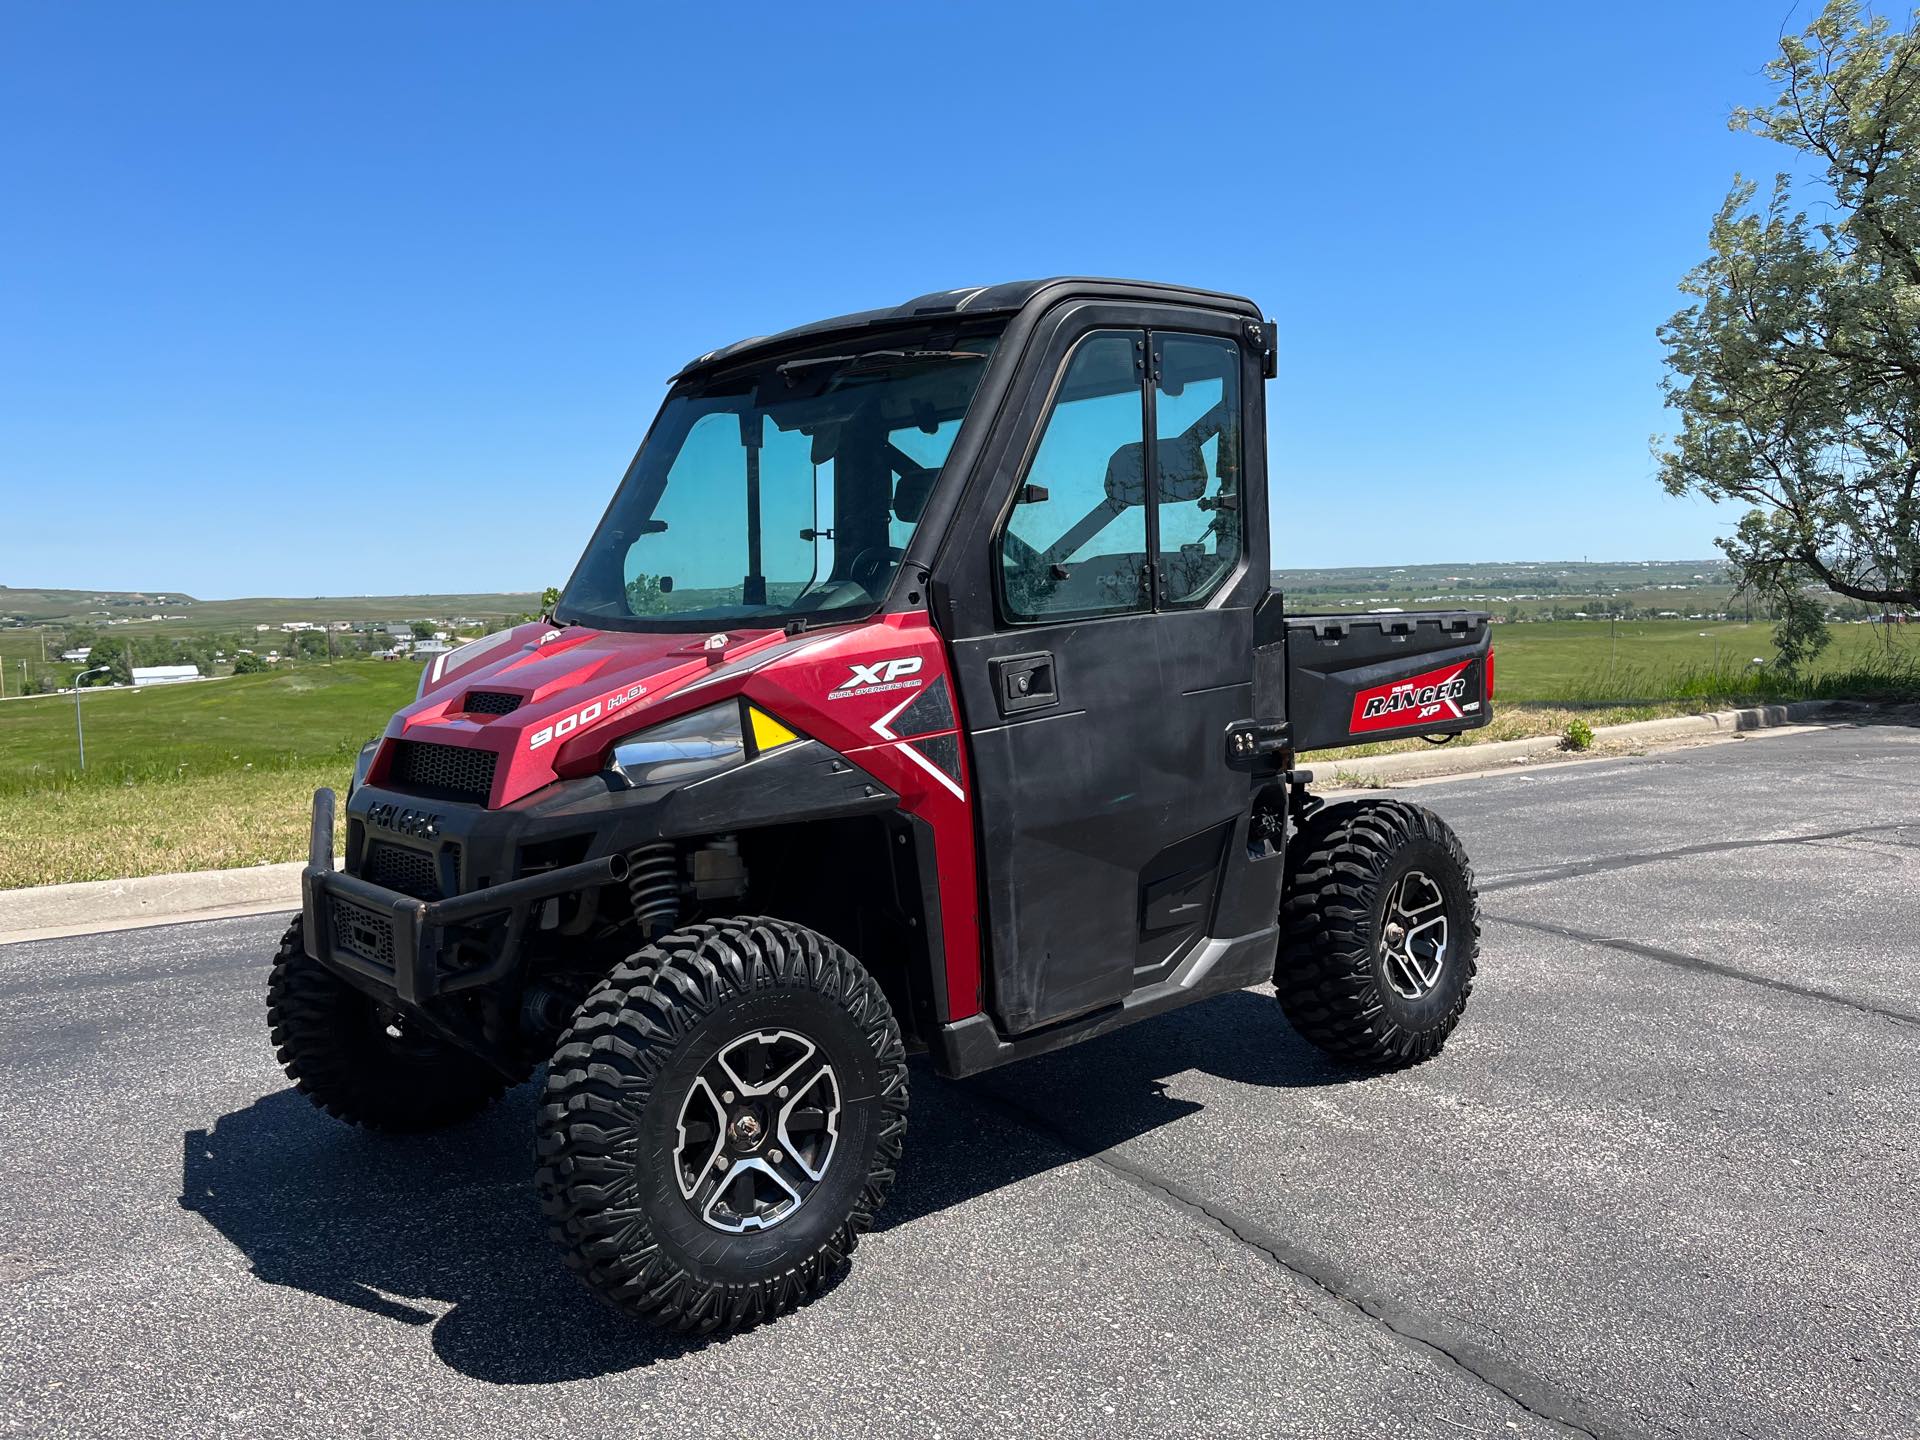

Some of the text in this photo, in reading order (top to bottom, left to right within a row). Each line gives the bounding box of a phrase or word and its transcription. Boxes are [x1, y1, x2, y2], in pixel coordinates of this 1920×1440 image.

[828, 679, 923, 701] DUAL OVERHEAD CAM
[838, 656, 923, 689] XP
[1362, 678, 1465, 719] RANGER
[1417, 704, 1441, 719] XP
[529, 701, 602, 751] 900
[607, 684, 647, 711] H.O.
[367, 801, 446, 840] POLARIS
